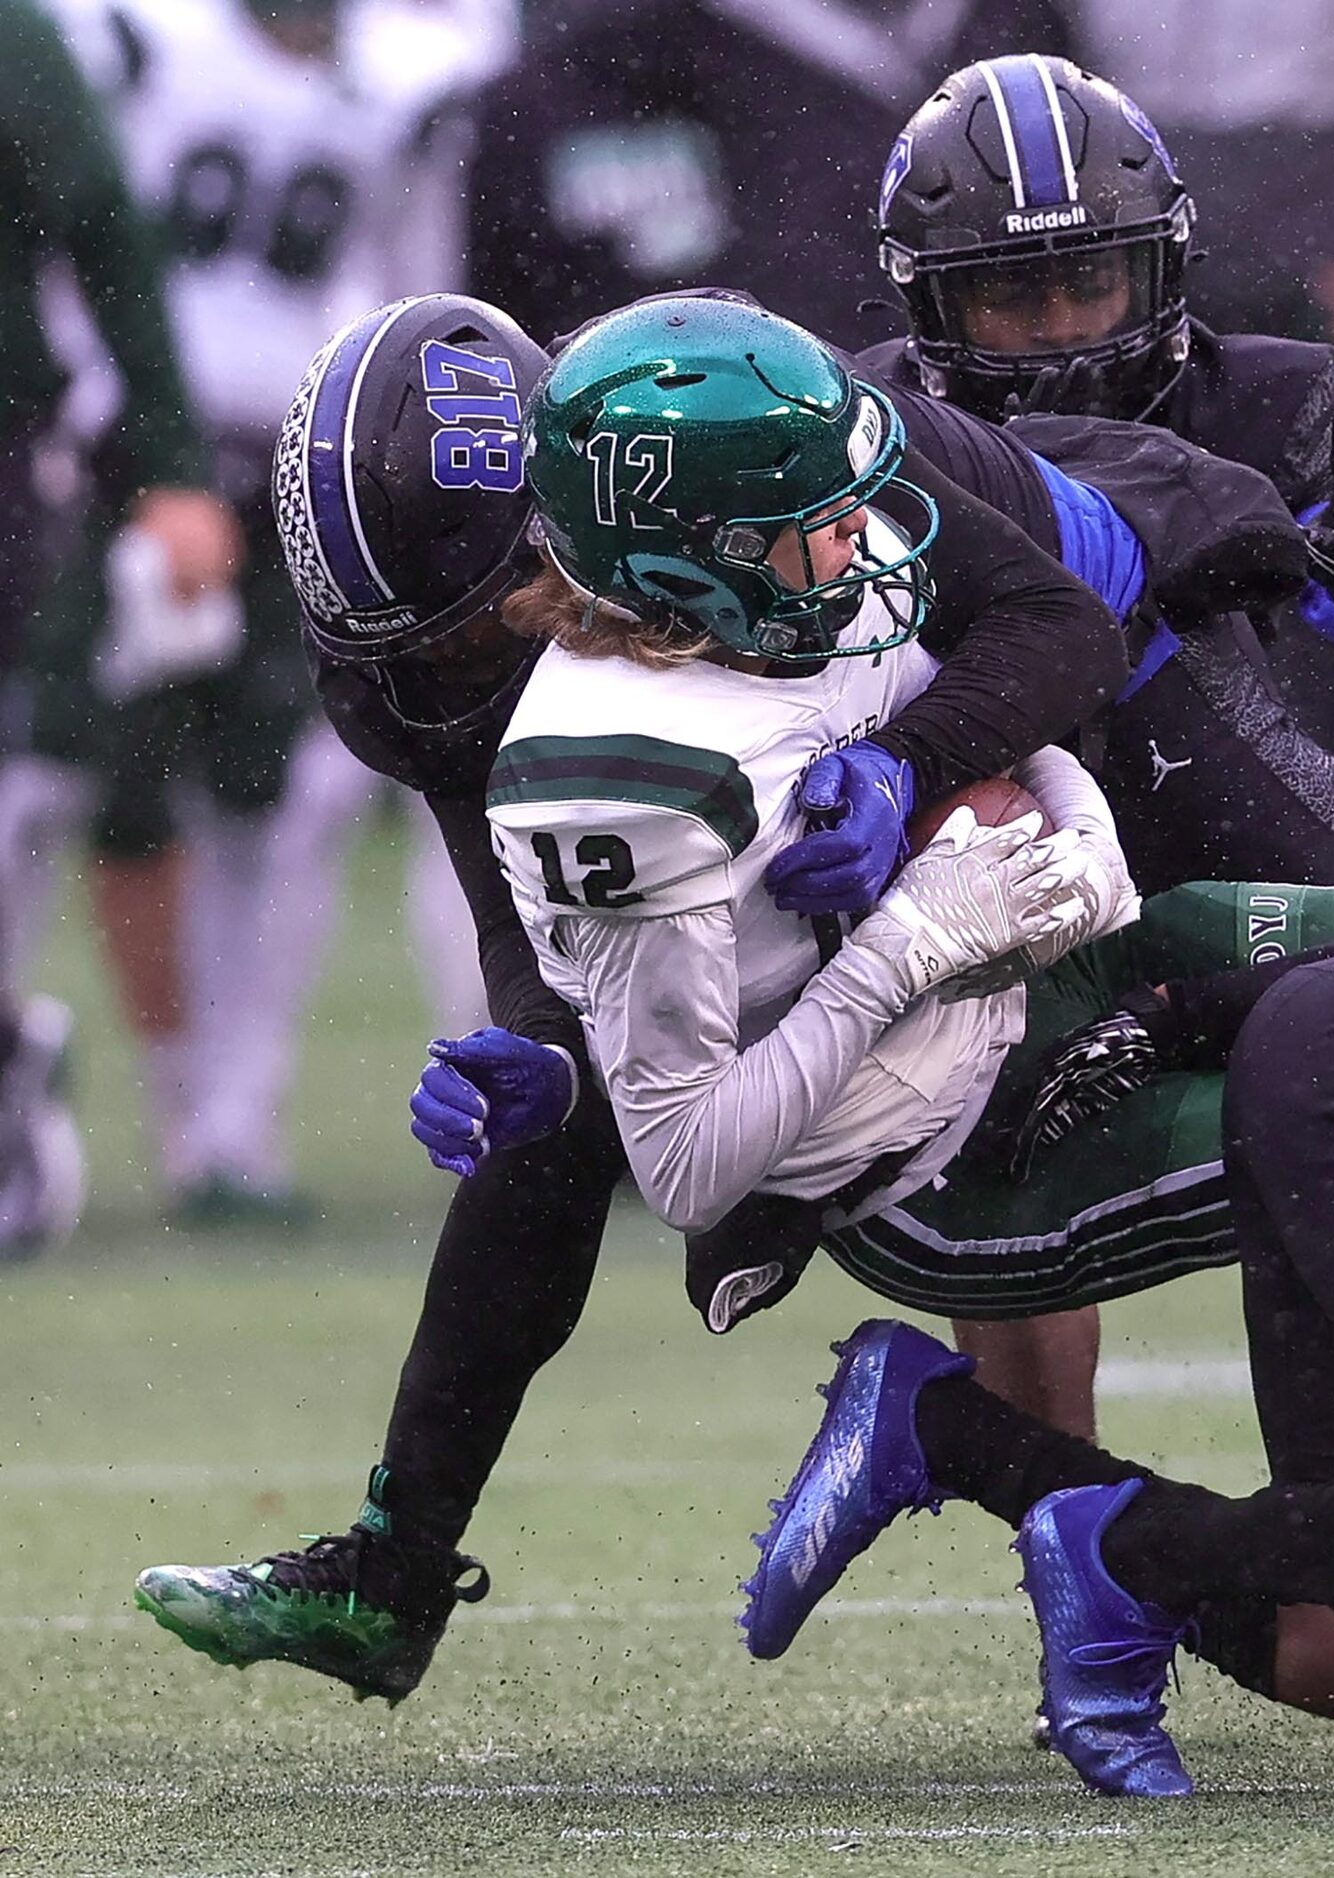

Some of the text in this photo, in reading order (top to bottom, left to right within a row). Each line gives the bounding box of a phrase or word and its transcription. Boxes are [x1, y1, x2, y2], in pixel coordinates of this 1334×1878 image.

[1006, 206, 1086, 233] Riddell
[421, 340, 524, 492] 817
[587, 431, 678, 528] 12
[531, 831, 647, 909] 12
